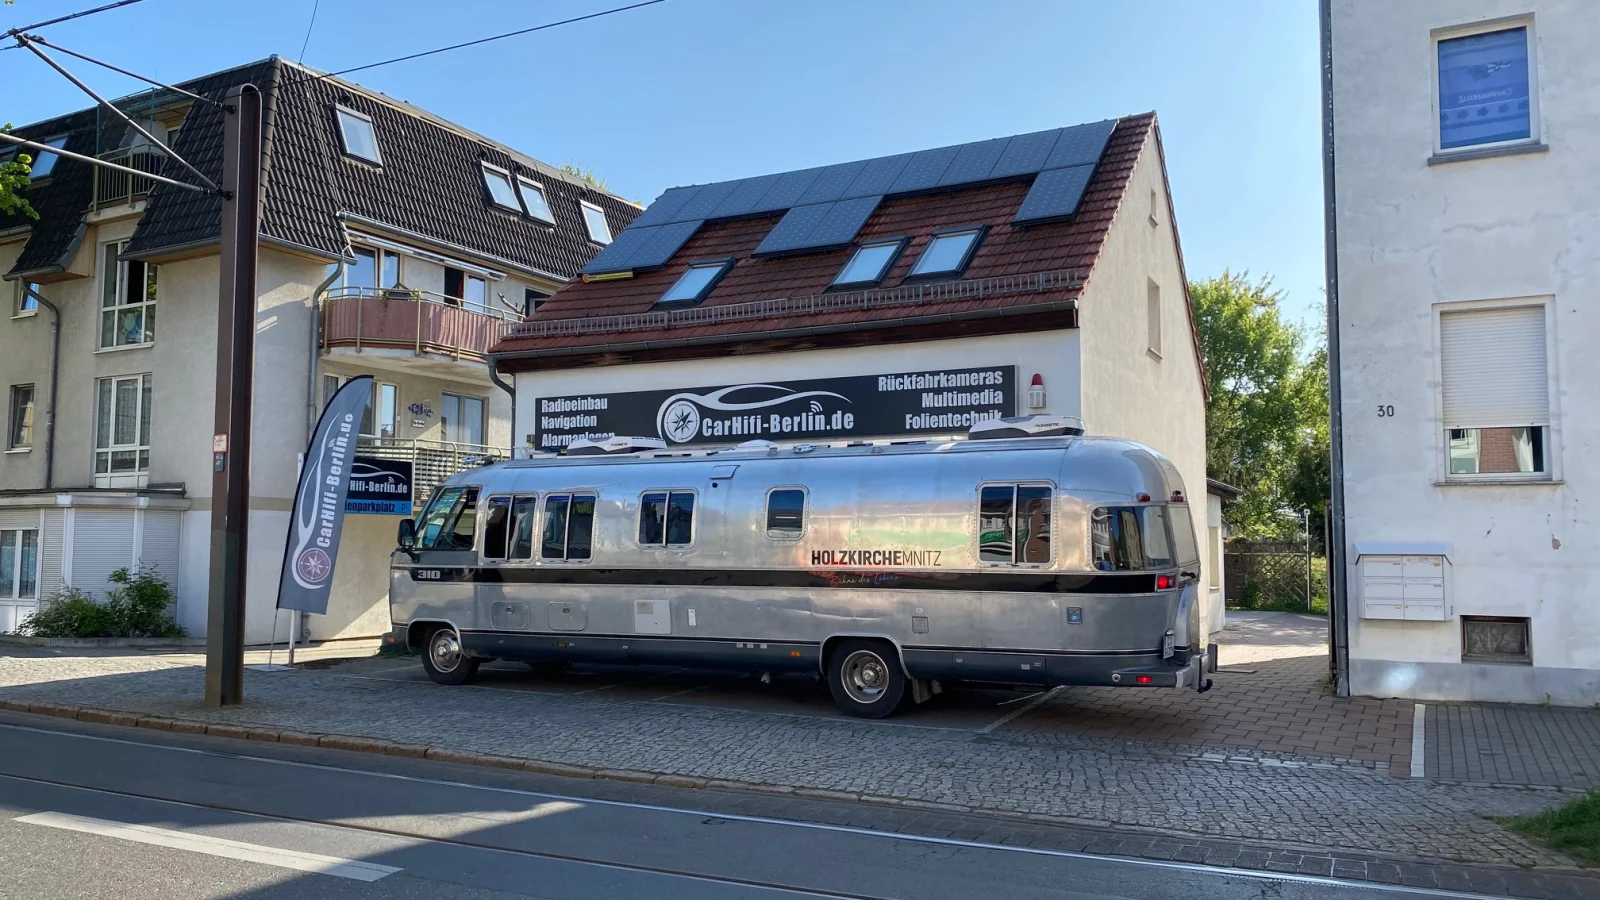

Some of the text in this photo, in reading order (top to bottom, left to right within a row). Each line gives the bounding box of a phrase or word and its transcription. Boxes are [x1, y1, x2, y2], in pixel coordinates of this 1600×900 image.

[878, 370, 1003, 392] Rückfahrkameras
[541, 396, 608, 413] Radioeinbau
[921, 388, 1003, 408] Multimedia
[1377, 404, 1395, 417] 30
[541, 413, 597, 430] Navigation
[701, 410, 854, 437] CarHifi-Berlin.de
[350, 480, 408, 494] Hifi-Berlin.de
[344, 501, 396, 513] enparkplatz
[811, 550, 942, 566] HOLZKIRCHEMNITZ
[417, 570, 441, 579] 310
